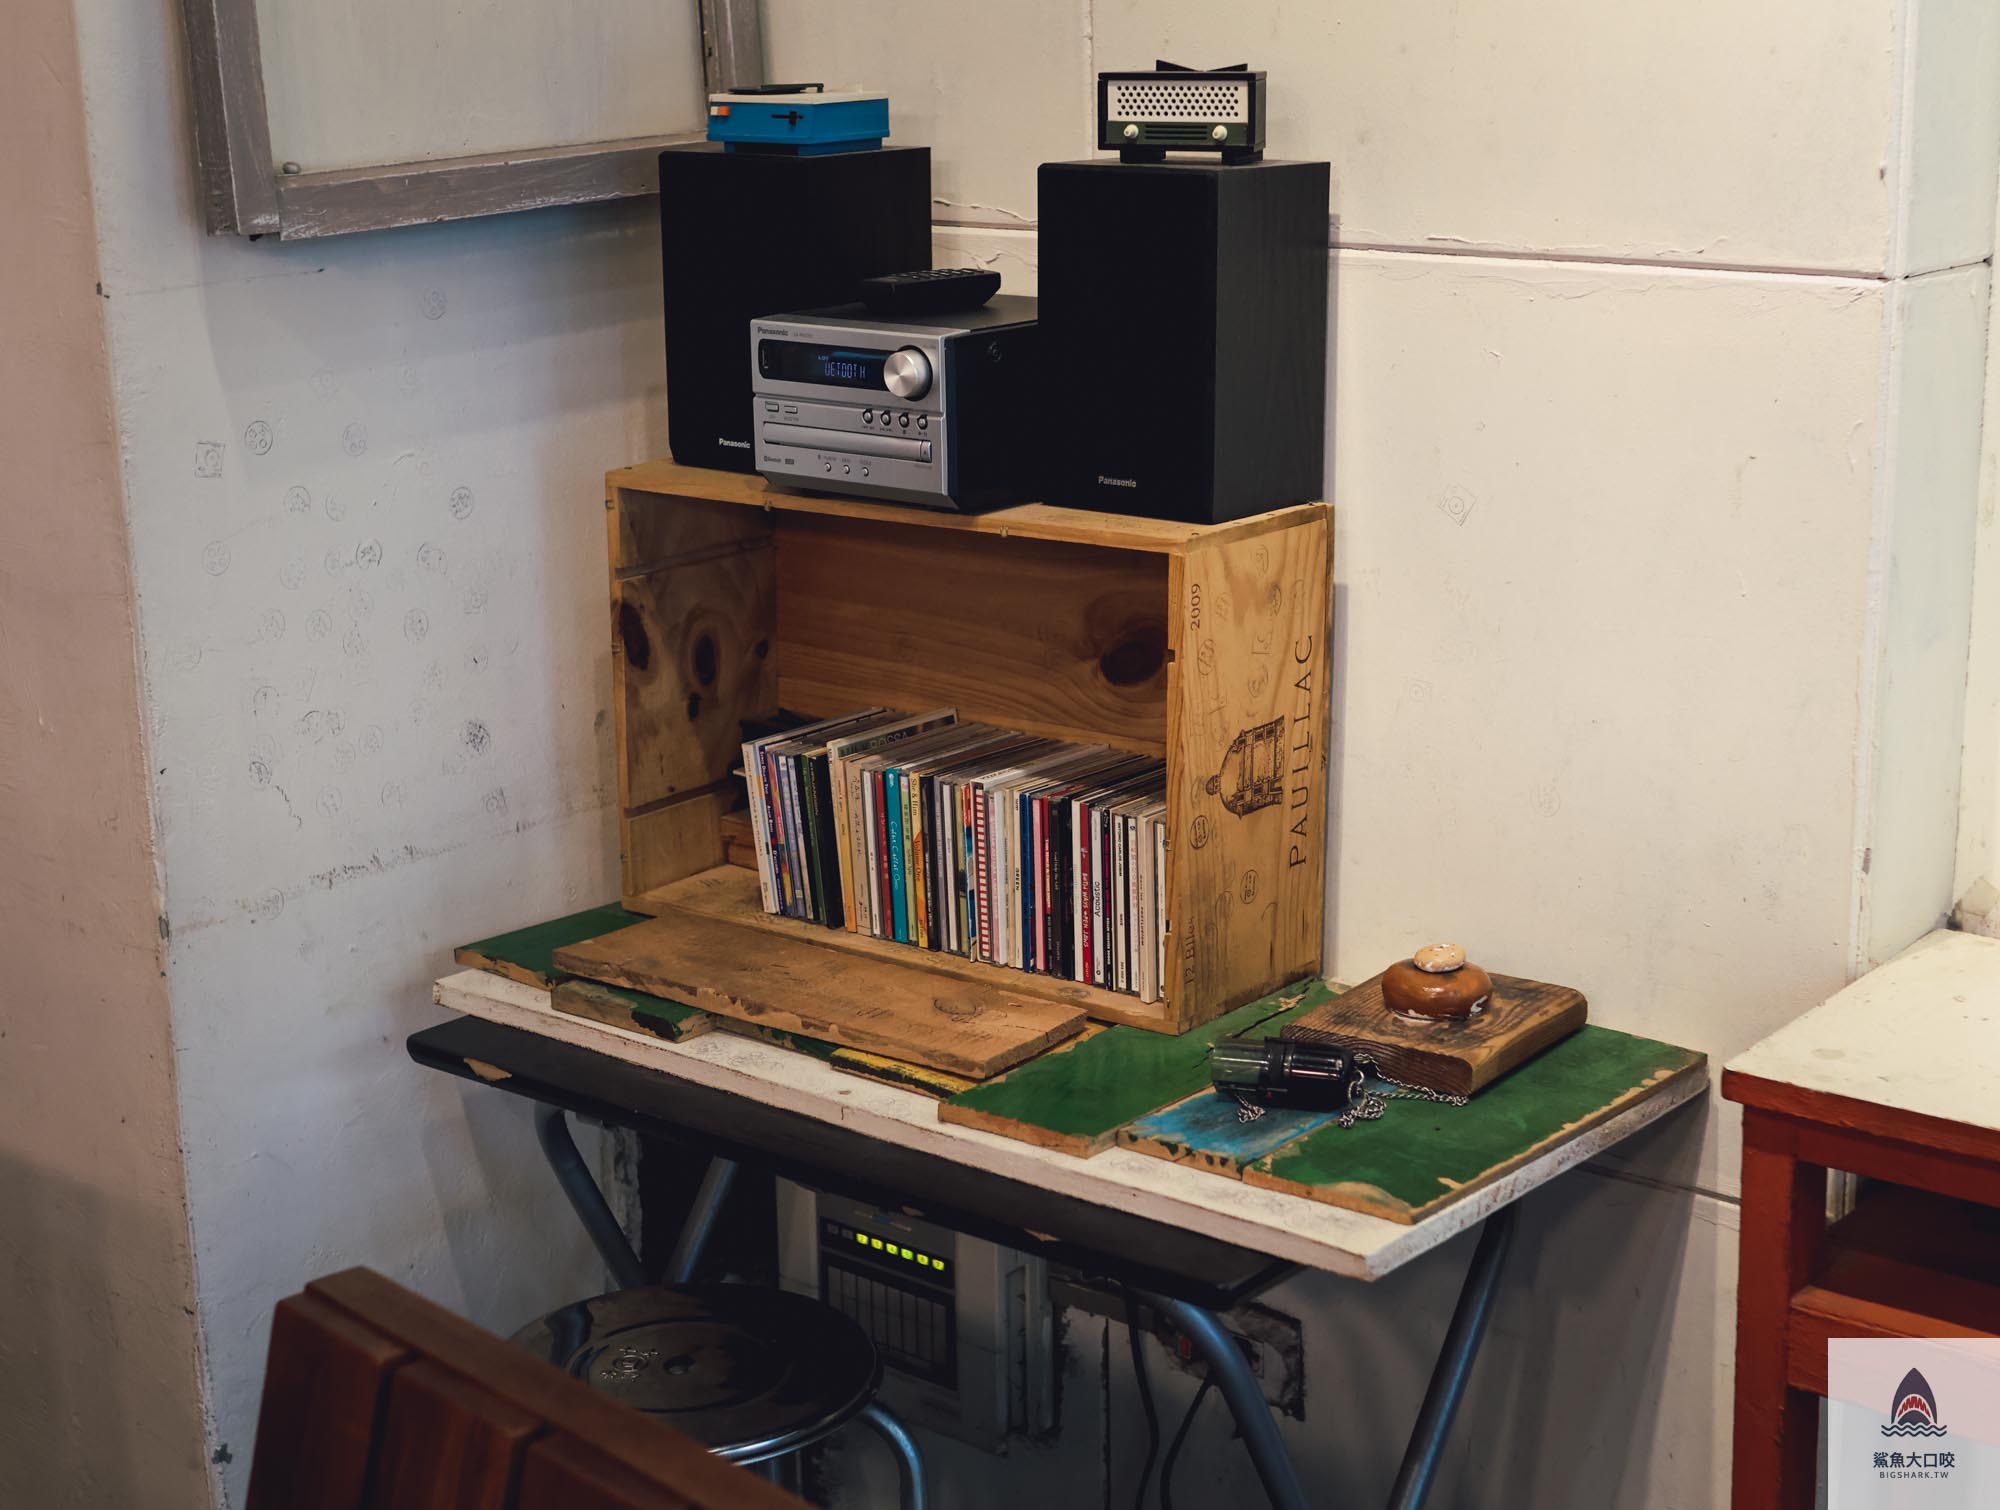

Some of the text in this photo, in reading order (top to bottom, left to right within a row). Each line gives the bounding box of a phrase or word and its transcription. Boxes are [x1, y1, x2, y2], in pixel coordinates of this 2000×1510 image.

[757, 326, 789, 337] Panasonic
[718, 437, 751, 449] Panasonic
[1097, 475, 1137, 488] Panasonic
[1190, 583, 1201, 631] 2009
[1289, 635, 1313, 868] PAUILLAC
[911, 800, 919, 816] Him
